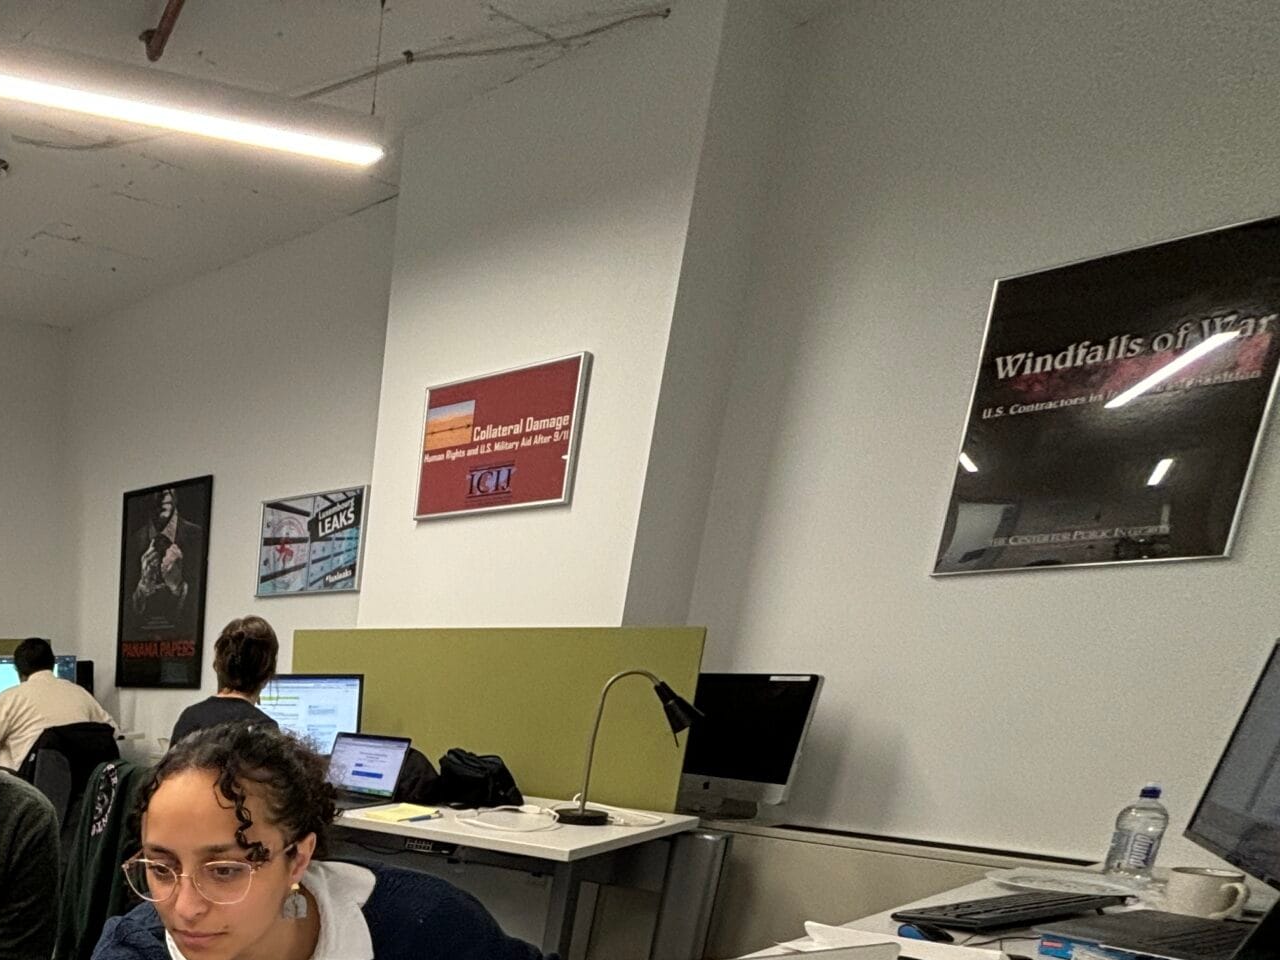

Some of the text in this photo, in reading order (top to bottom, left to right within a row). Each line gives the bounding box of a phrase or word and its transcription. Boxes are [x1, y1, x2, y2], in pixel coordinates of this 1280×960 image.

[995, 313, 1278, 380] Windfalls of War
[982, 406, 1006, 419] U.S.
[1009, 396, 1087, 415] Contractors
[473, 414, 570, 441] Collateral Damage
[424, 429, 569, 463] Human Rights and U.S. Military Aid After 9/11
[468, 468, 513, 495] ICIJ
[318, 507, 355, 537] LEAKS
[122, 640, 196, 657] PANAMA PAPERS
